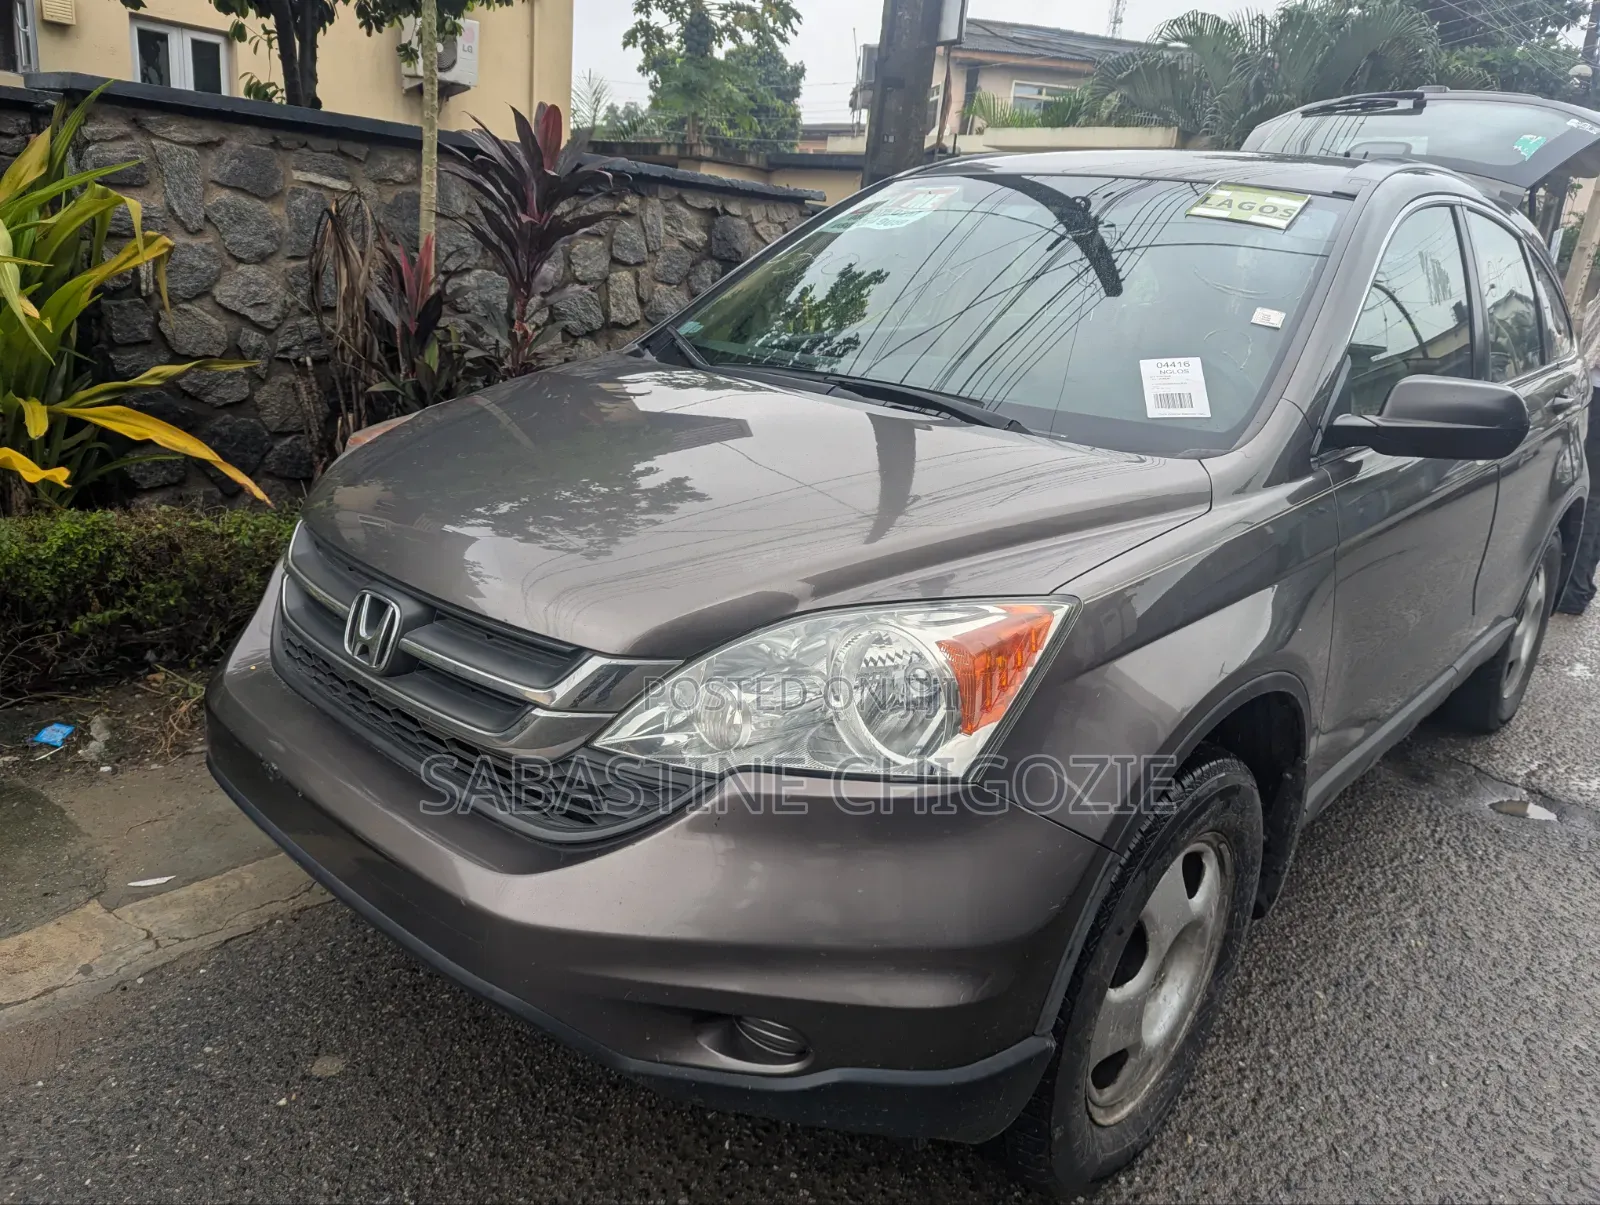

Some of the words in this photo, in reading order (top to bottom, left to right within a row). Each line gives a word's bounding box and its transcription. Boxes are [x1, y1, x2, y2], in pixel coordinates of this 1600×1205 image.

[462, 44, 473, 53] LG
[1200, 196, 1298, 218] LAGOS
[1156, 360, 1191, 369] 04416
